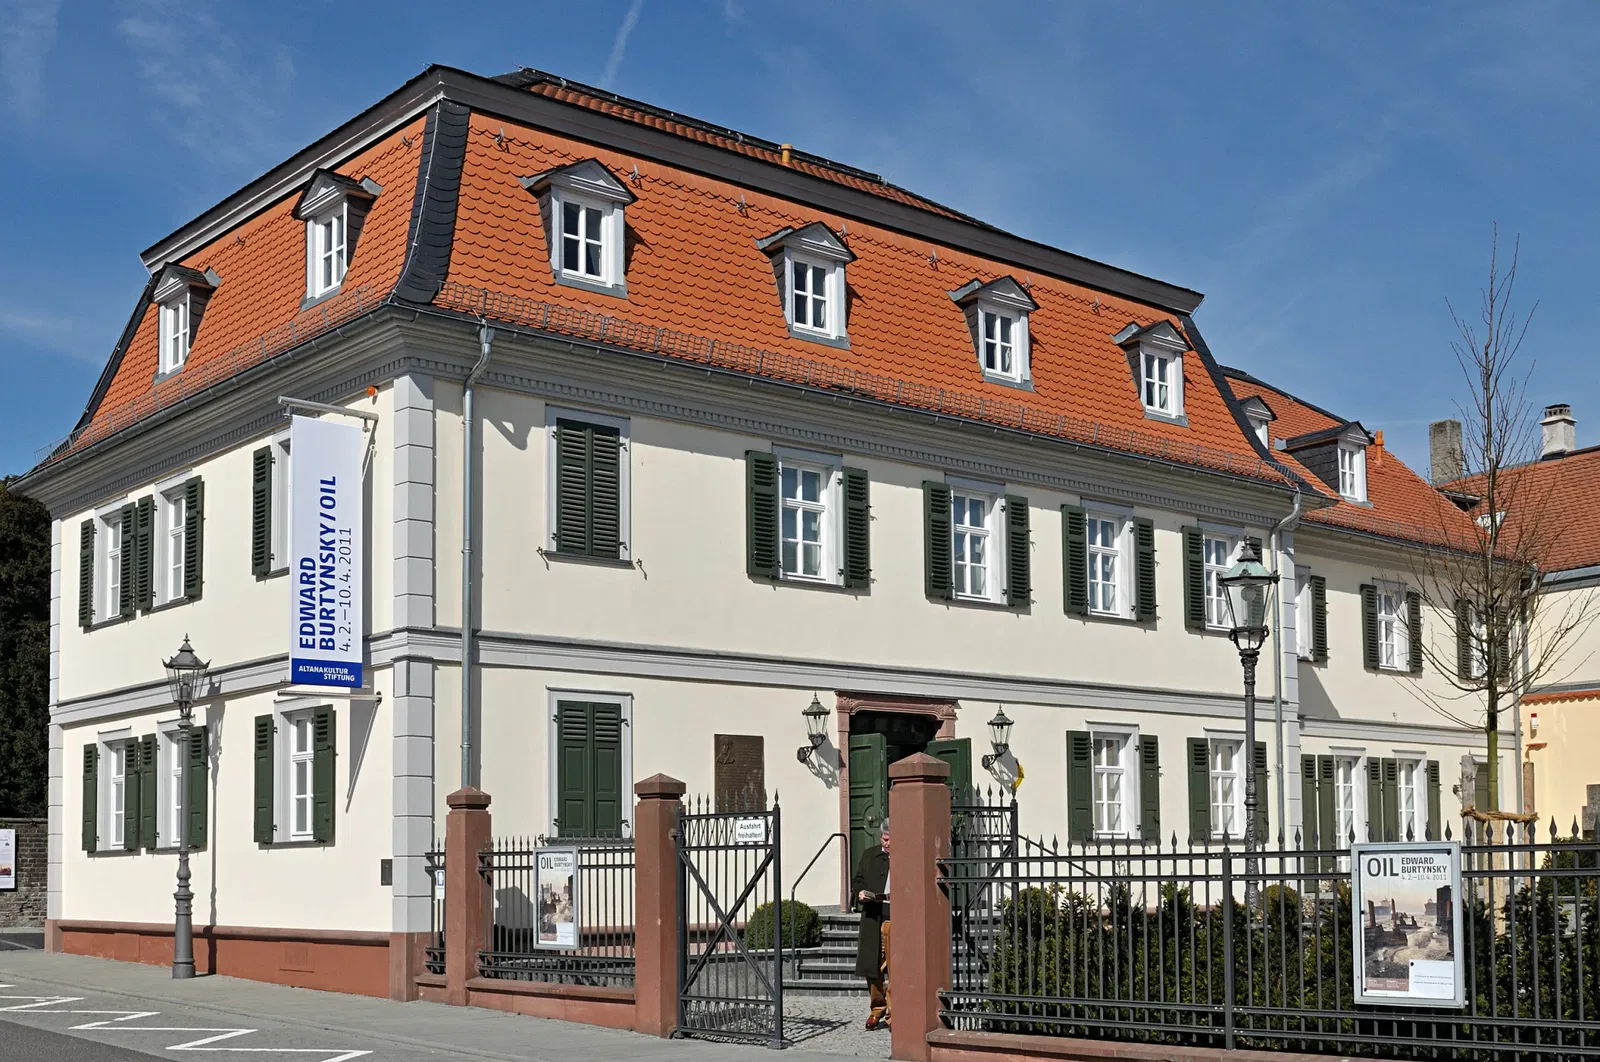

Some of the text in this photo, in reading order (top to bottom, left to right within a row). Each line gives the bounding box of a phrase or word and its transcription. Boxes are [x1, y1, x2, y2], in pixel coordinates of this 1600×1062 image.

[299, 557, 316, 649] EDWARD
[323, 673, 355, 682] STIFTUNG
[541, 857, 554, 870] OIL
[1401, 857, 1434, 865] EDWARD
[1367, 857, 1399, 878] OIL
[1401, 865, 1448, 874] BURTYNSKY
